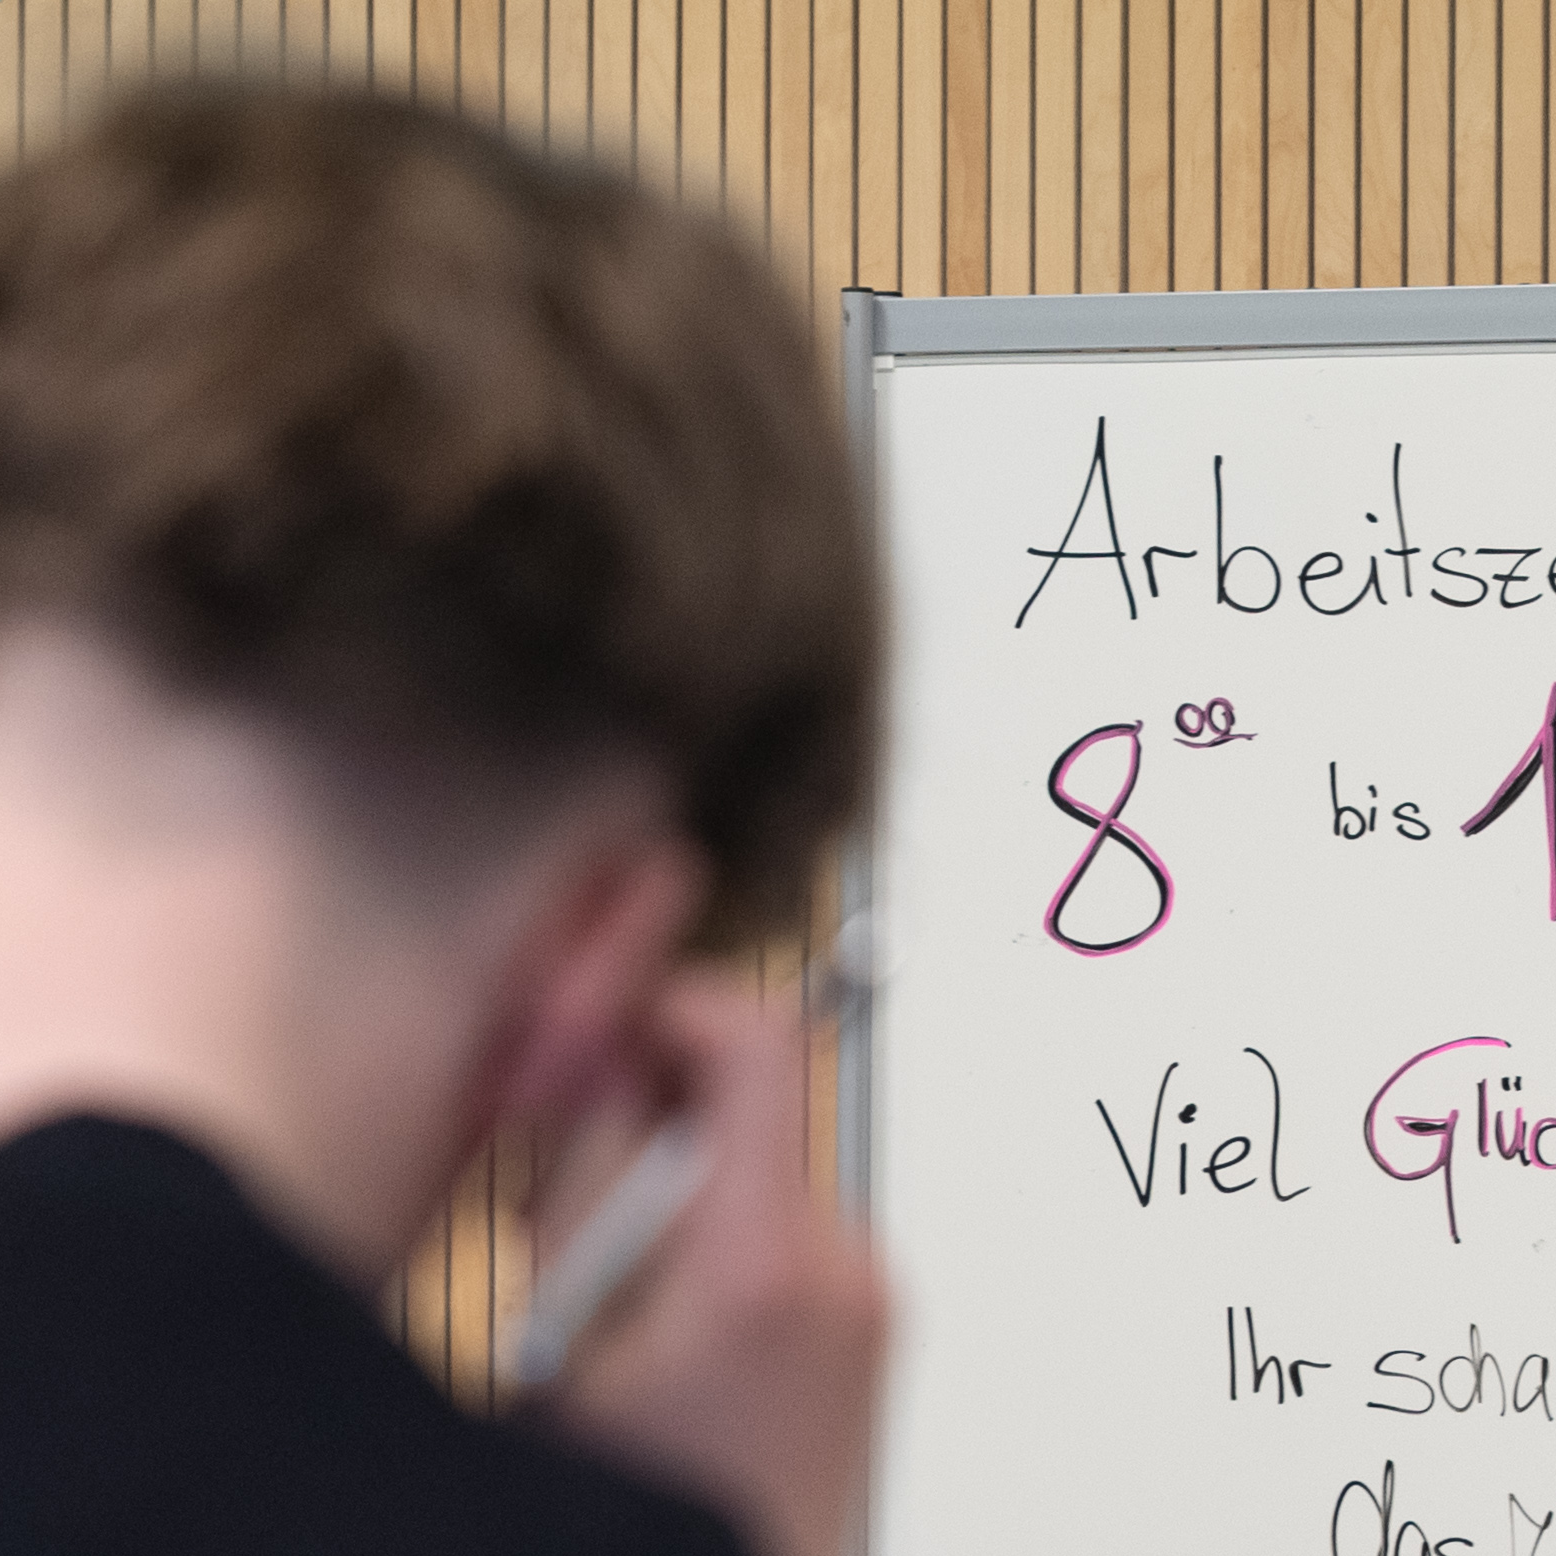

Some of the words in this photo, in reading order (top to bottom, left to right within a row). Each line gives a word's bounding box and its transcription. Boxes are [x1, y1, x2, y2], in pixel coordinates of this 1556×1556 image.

[1329, 761, 1431, 841] bis
[1095, 1047, 1311, 1208] Viel
[1227, 1306, 1332, 1404] Ihr
